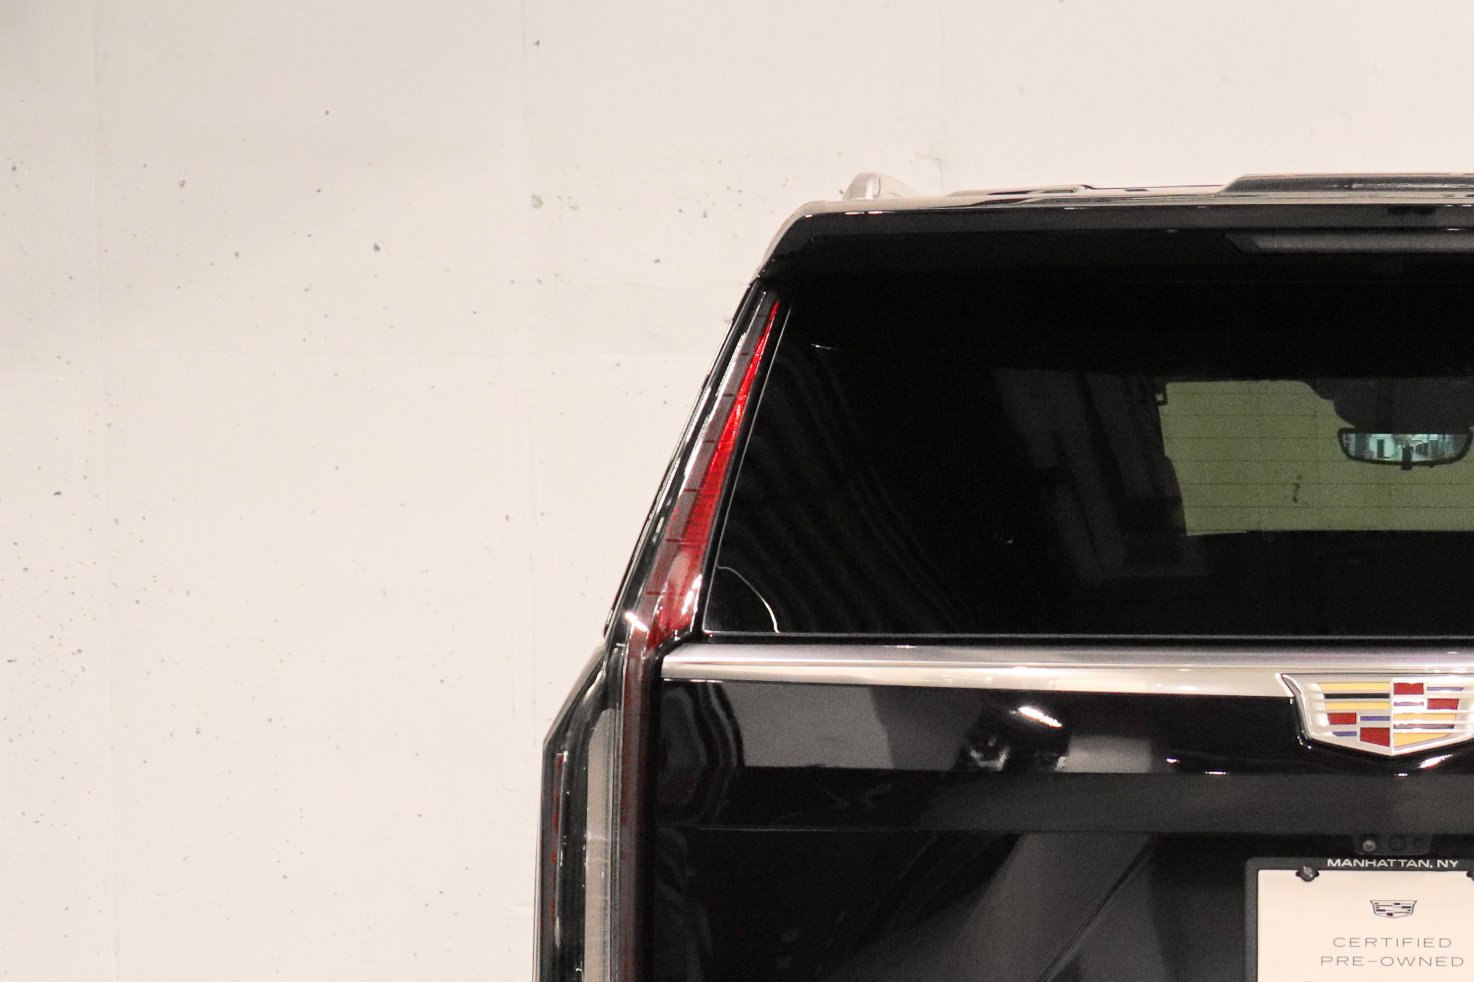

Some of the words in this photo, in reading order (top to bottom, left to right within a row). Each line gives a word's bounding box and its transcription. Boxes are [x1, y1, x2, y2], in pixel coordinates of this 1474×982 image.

[1436, 859, 1459, 869] NY
[1332, 936, 1453, 949] CERTIFIED
[1320, 955, 1465, 967] PRE-OWNED
